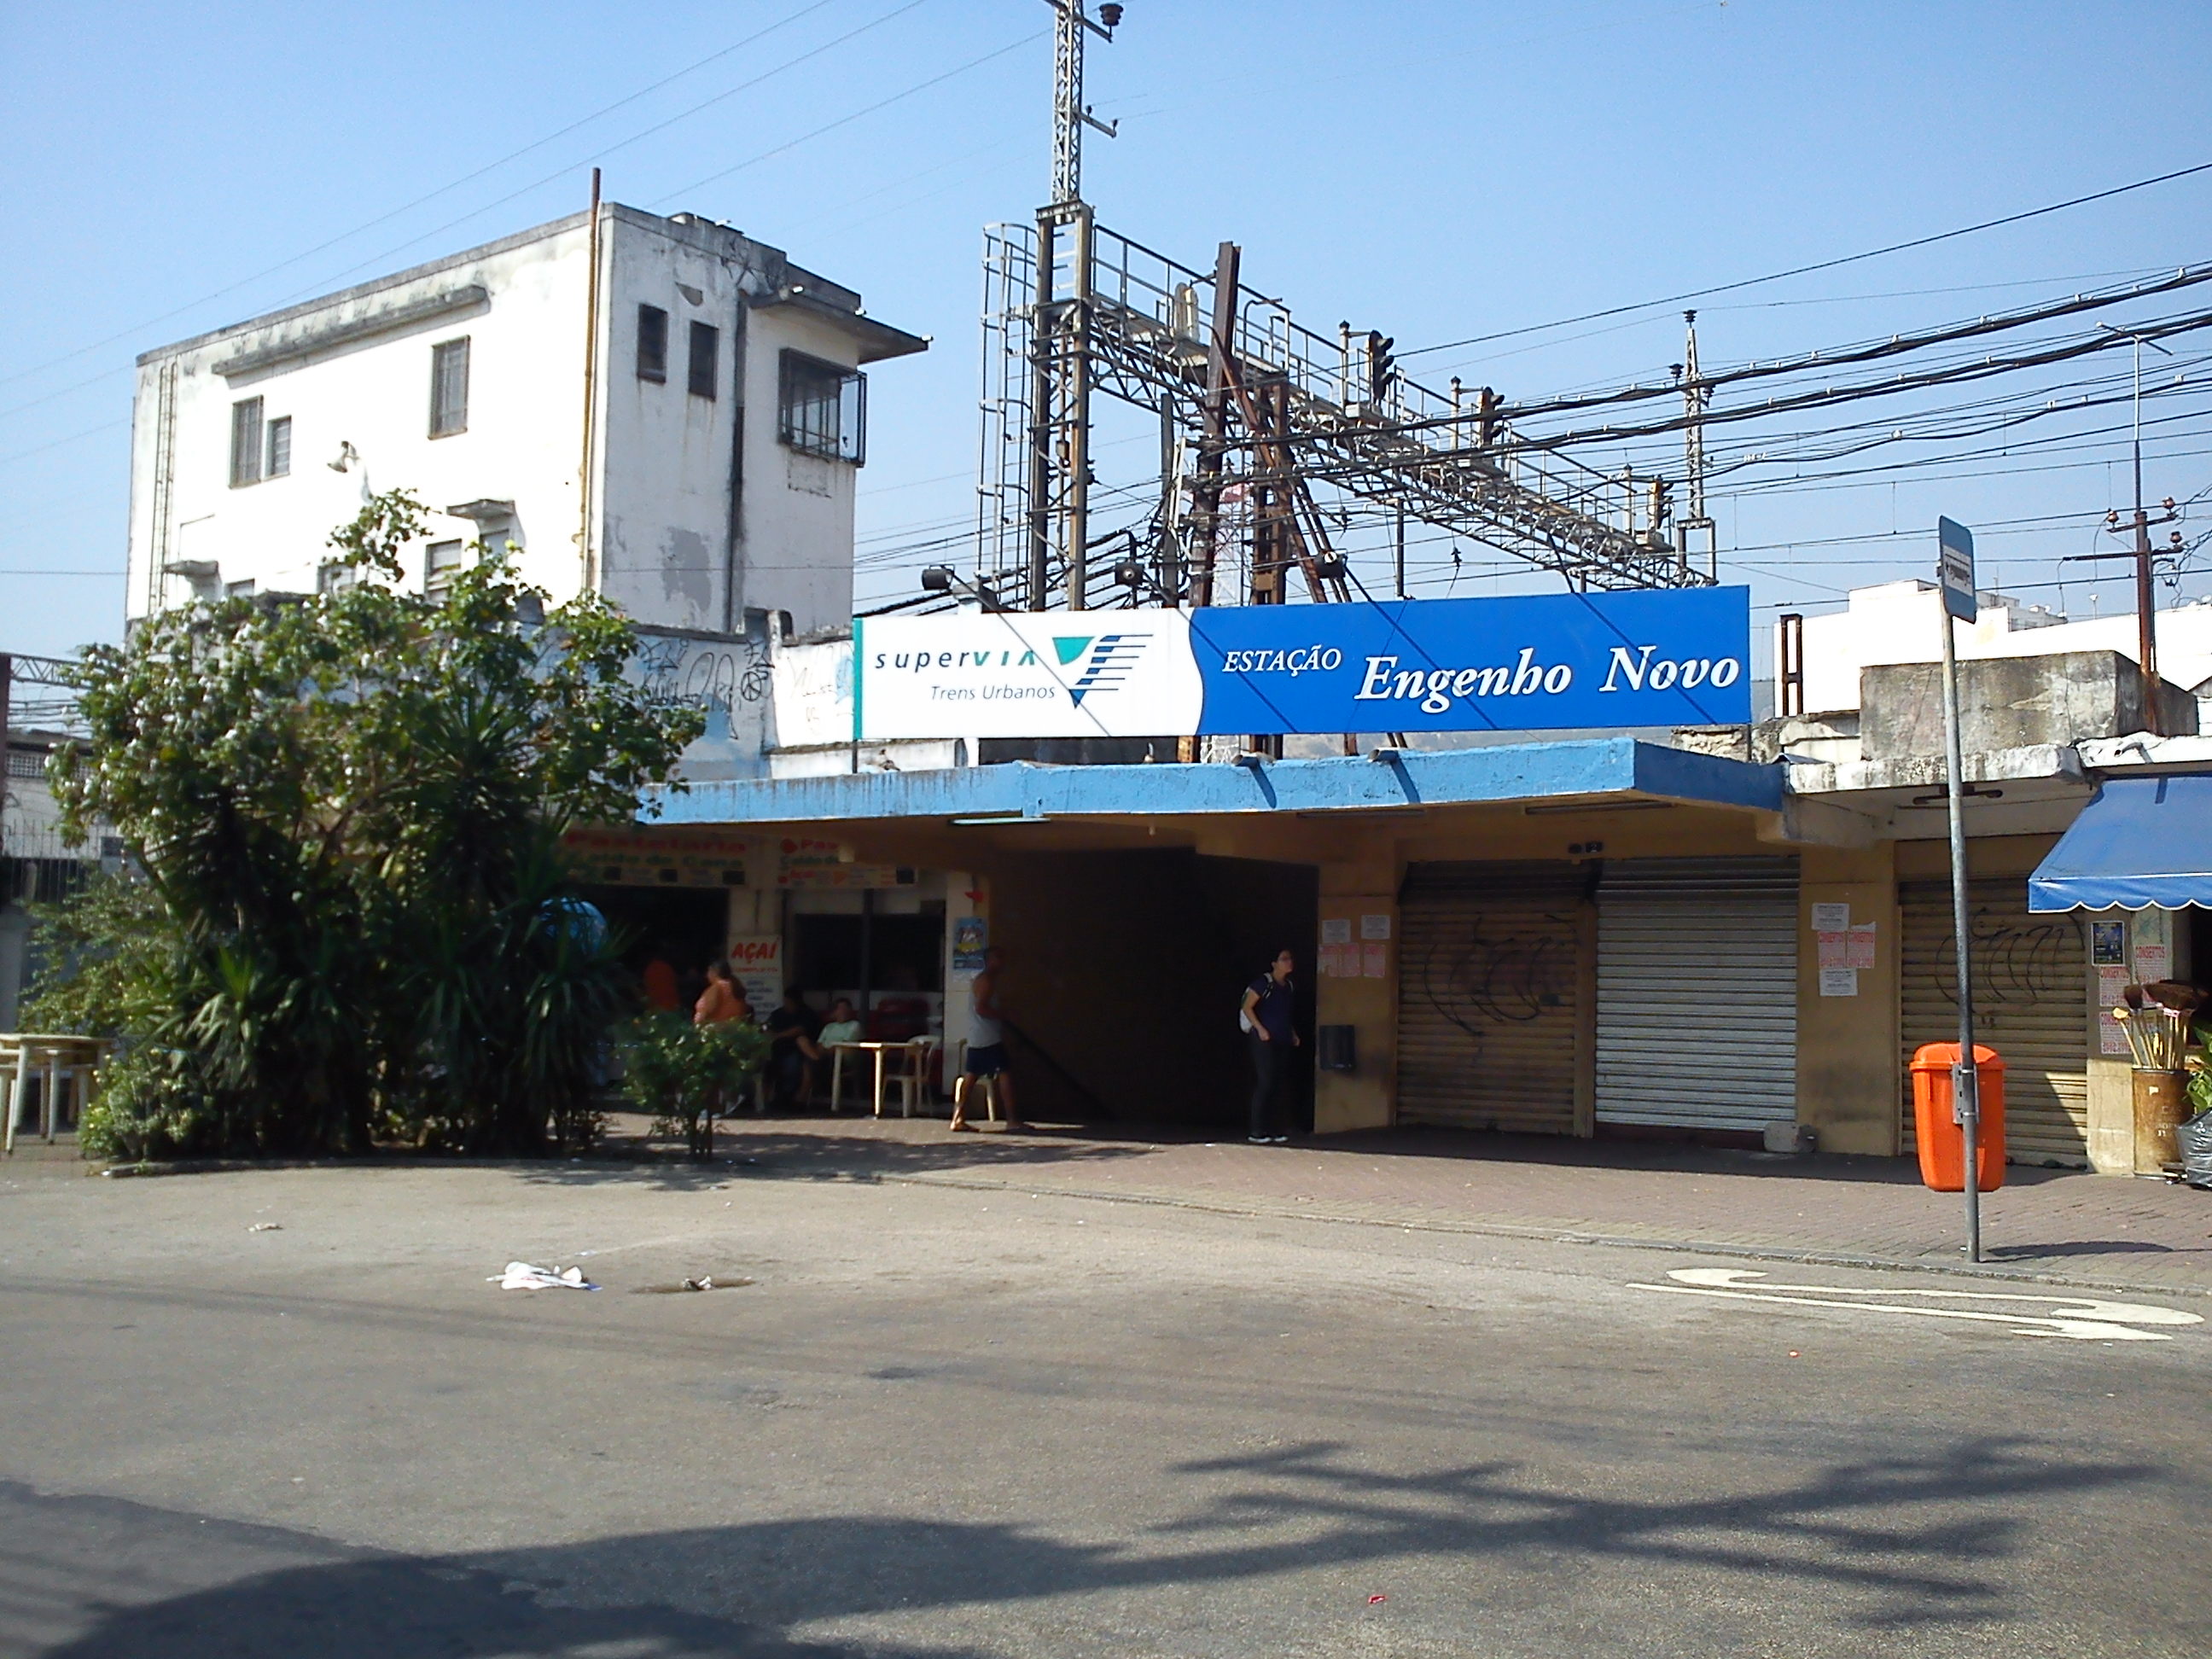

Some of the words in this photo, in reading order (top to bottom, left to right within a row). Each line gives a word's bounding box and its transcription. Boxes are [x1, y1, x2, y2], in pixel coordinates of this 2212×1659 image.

[931, 685, 975, 701] Trens
[982, 684, 1056, 700] Urbanos
[1222, 644, 1342, 678] ESTAÇÃO
[1354, 647, 1573, 715] Engenho
[1599, 644, 1740, 693] Novo
